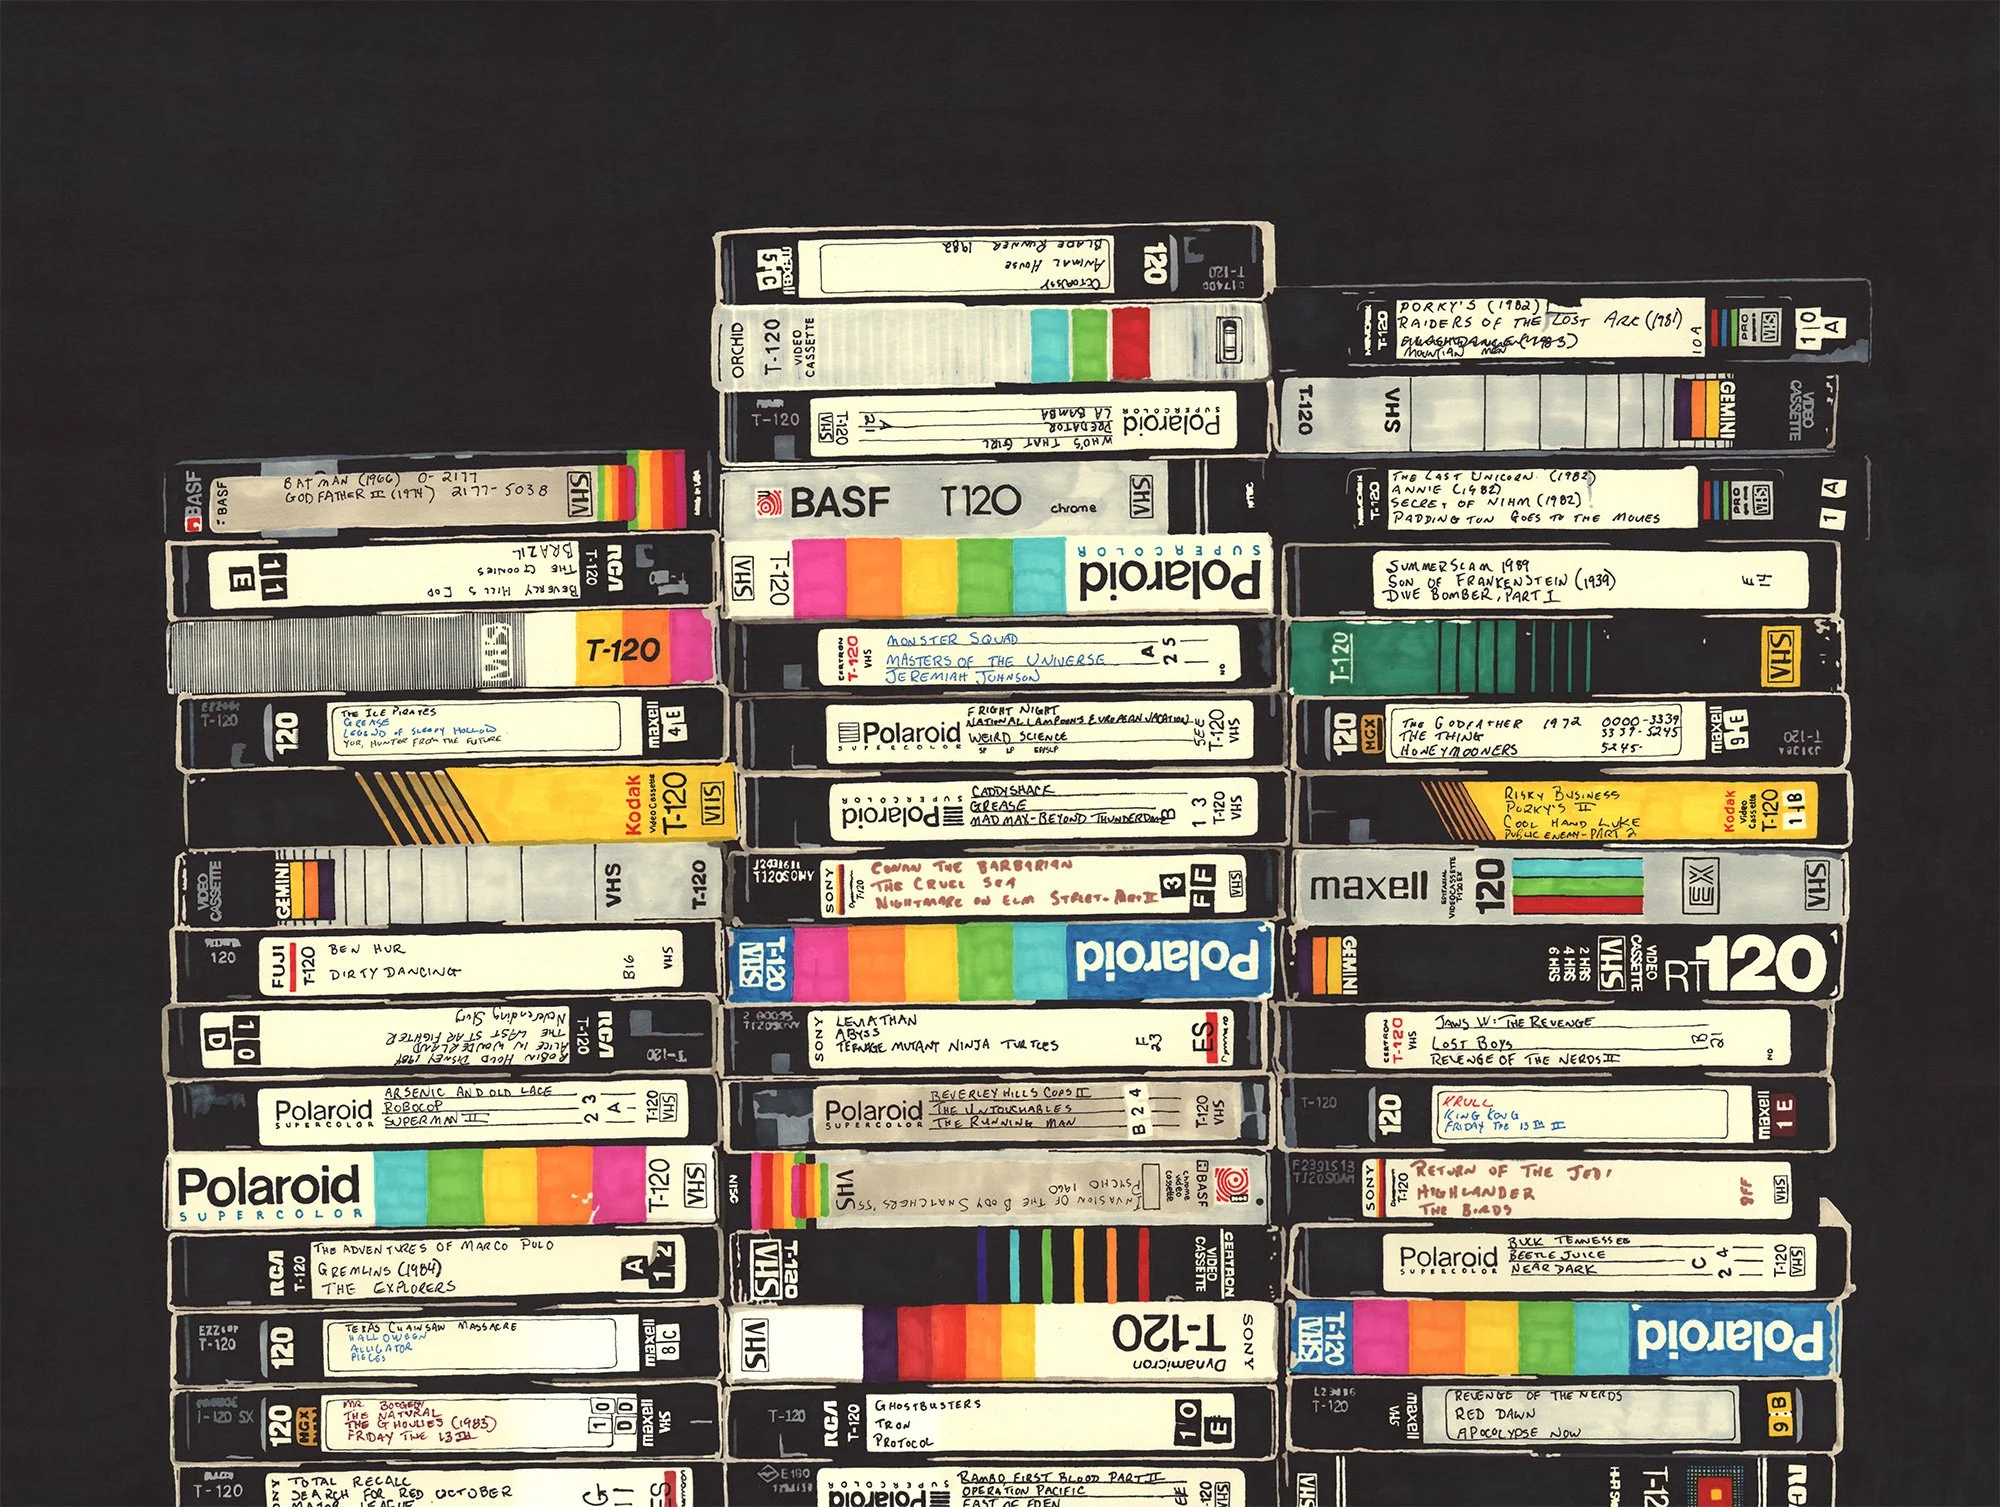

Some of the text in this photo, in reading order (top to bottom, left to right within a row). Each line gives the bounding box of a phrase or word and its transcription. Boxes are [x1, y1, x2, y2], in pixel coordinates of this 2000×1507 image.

[730, 323, 744, 378] ORCHID
[763, 319, 781, 375] T-120
[793, 330, 802, 365] VIDEO
[805, 318, 815, 377] CASSETTE
[1378, 311, 1388, 350] T-120
[1124, 414, 1219, 436] Polaroid
[1385, 388, 1400, 433] VHS
[1720, 379, 1736, 439] GEMINI
[185, 471, 202, 521] BASF
[792, 486, 890, 518] BASF
[1051, 503, 1097, 513] chrome
[1130, 475, 1154, 518] VHS
[1078, 545, 1260, 557] SUPERCOLOR
[770, 551, 789, 605] T-120
[1080, 559, 1261, 601] Polaroid
[587, 638, 660, 662] T-120
[847, 636, 858, 682] T-120
[863, 649, 872, 668] VHS
[1330, 632, 1349, 684] T-120
[1767, 630, 1794, 683] VHS
[275, 712, 298, 754] 120
[647, 701, 659, 748] maxell
[864, 722, 961, 743] Polaroid
[1209, 709, 1224, 752] T-120
[1333, 713, 1357, 756] 120
[1710, 706, 1722, 753] maxell
[626, 775, 641, 835] Kodak
[662, 772, 687, 833] T-120
[842, 806, 939, 829] Polaroid
[1724, 791, 1735, 832] Kodak
[1761, 789, 1778, 832] T-120
[276, 862, 290, 919] GEMINI
[605, 864, 621, 907] VHS
[692, 860, 707, 910] T-120
[825, 869, 834, 913] SONY
[1311, 871, 1427, 900] maxell
[1476, 858, 1505, 914] 120
[1805, 860, 1829, 910] VHS
[272, 946, 285, 988] FUJI
[766, 936, 786, 991] T-120
[1076, 939, 1259, 981] Polaroid
[1342, 936, 1358, 994] GEMINI
[1579, 958, 1591, 981] HRS
[1630, 934, 1643, 991] CASSETTE
[1646, 945, 1657, 980] VIDEO
[815, 1017, 823, 1061] SONY
[276, 1099, 372, 1121] Polaroid
[276, 1121, 373, 1129] SUPERCOLOR
[826, 1100, 923, 1121] Polaroid
[1378, 1094, 1402, 1136] 120
[1758, 1091, 1770, 1139] maxell
[178, 1164, 359, 1207] Polaroid
[648, 1159, 670, 1213] T-120
[836, 1170, 855, 1210] VHS
[1366, 1165, 1375, 1210] SONY
[180, 1209, 362, 1222] SUPERCOLOR
[269, 1251, 284, 1296] RCA
[294, 1256, 305, 1291] T-120
[784, 1240, 798, 1298] T-120
[1195, 1237, 1206, 1291] CASSETTE
[1207, 1247, 1217, 1281] VIDEO
[1221, 1229, 1234, 1299] CERTRON
[1400, 1246, 1498, 1267] Polaroid
[270, 1327, 294, 1369] 120
[643, 1319, 655, 1366] maxell
[745, 1322, 766, 1368] VHS
[1113, 1314, 1226, 1352] T-120
[1243, 1314, 1253, 1370] SONY
[1638, 1319, 1823, 1361] Polaroid
[1133, 1358, 1226, 1372] Dynamicron
[824, 1401, 838, 1446] RCA
